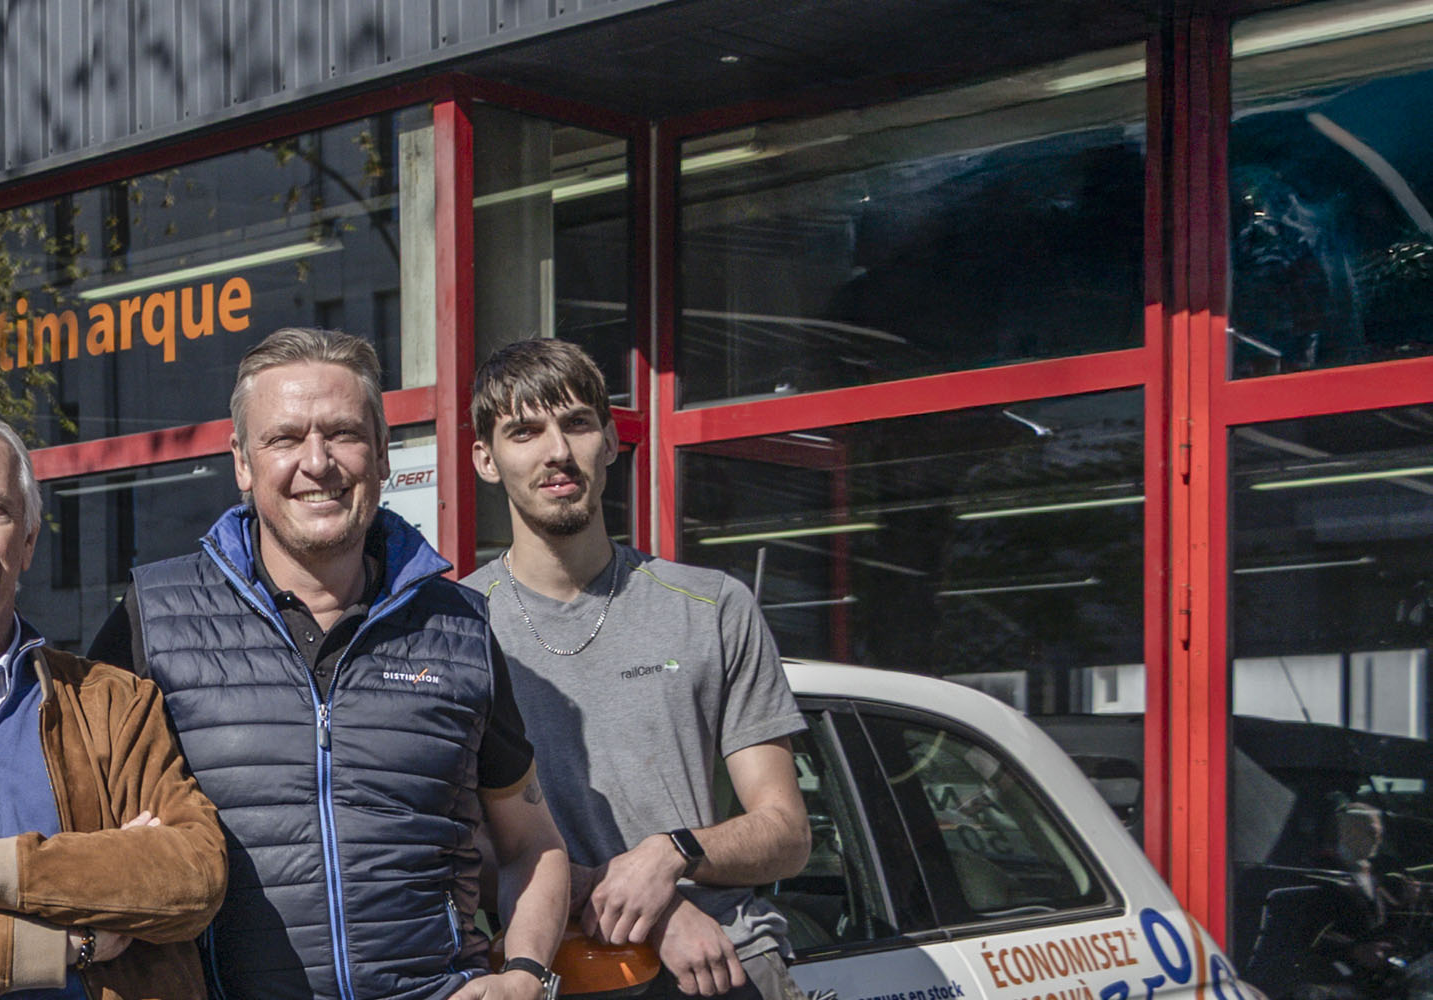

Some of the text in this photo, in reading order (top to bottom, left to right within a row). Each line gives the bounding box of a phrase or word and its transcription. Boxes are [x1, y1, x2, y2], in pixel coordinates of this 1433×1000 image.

[383, 669, 439, 684] DISTINXION
[621, 664, 662, 679] railCare
[927, 980, 965, 1000] stock
